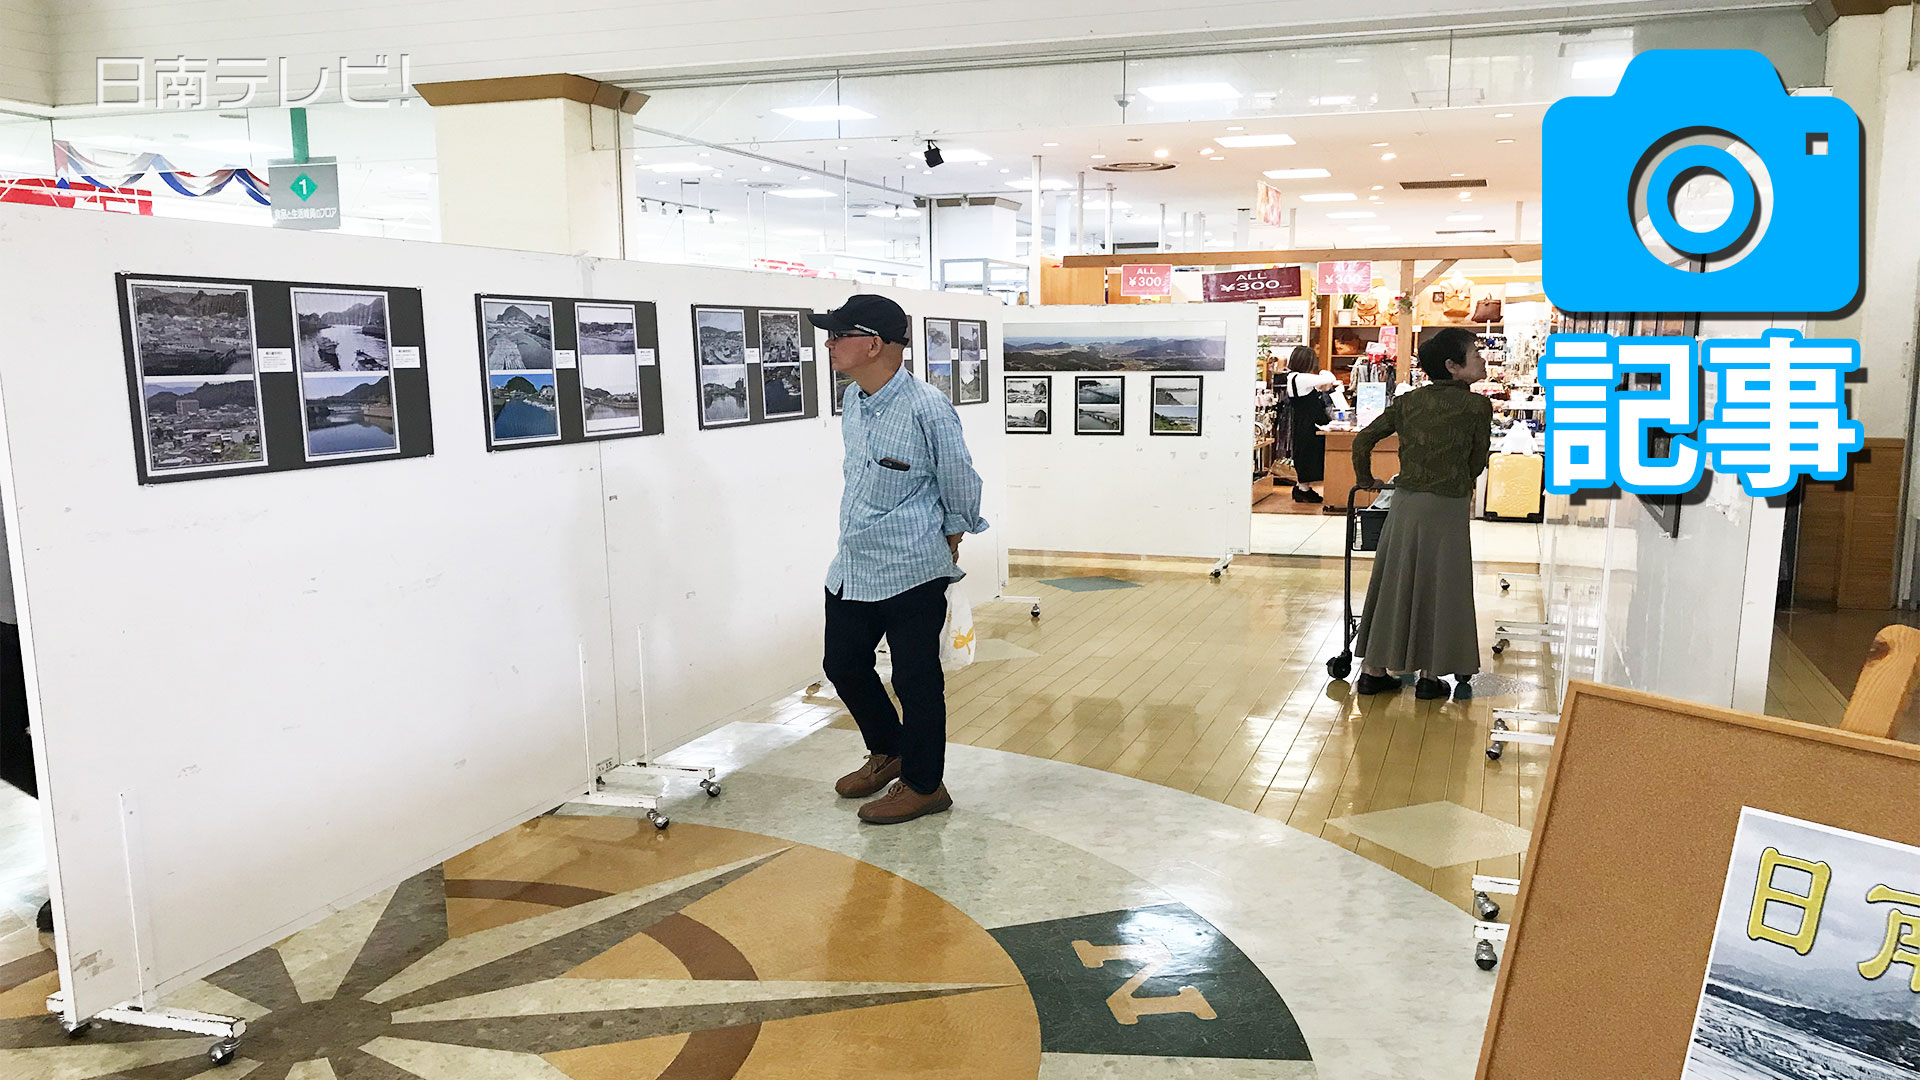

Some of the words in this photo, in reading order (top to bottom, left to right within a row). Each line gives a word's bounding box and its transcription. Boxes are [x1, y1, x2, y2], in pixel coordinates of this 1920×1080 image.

[298, 178, 307, 195] 1
[1136, 267, 1157, 275] ALL
[1236, 272, 1267, 281] ALL
[1128, 276, 1162, 287] ¥300
[1220, 280, 1280, 292] ¥300
[1071, 940, 1218, 1025] N
